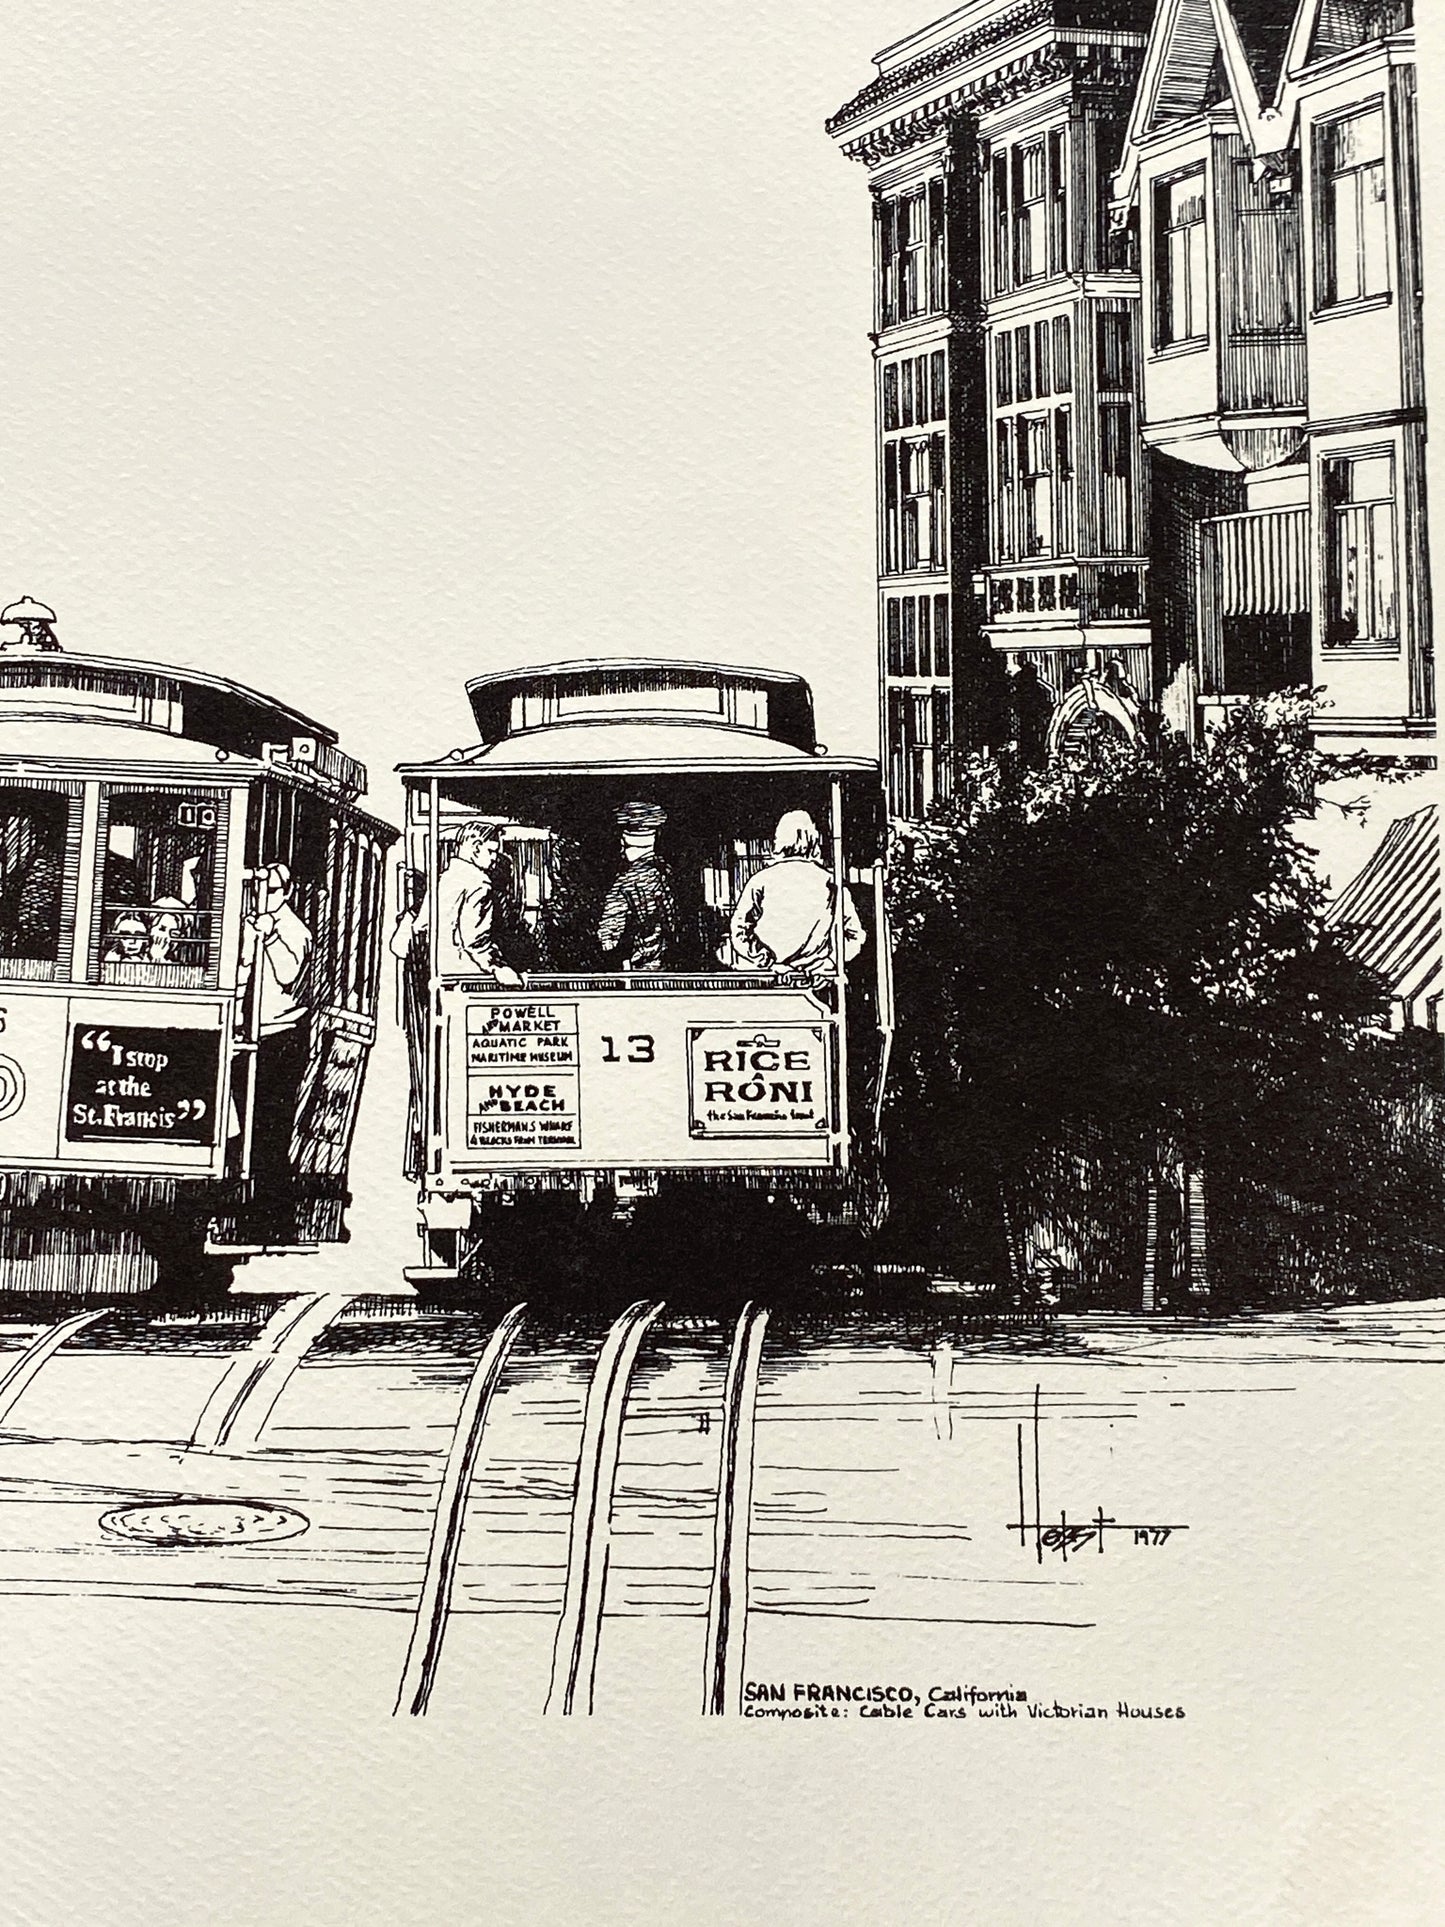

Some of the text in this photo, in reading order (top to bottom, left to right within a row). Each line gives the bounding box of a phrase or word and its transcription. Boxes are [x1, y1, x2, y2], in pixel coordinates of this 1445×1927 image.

[490, 1006, 555, 1019] POWELL
[499, 1020, 561, 1032] MARKET
[472, 1036, 568, 1048] AQUATIC PARK
[601, 1034, 655, 1063] 13
[126, 1051, 169, 1072] stop
[471, 1050, 573, 1062] MARITIME MUSEUM
[704, 1050, 811, 1071] RICE
[95, 1075, 152, 1097] at the
[489, 1084, 557, 1098] HYDE
[479, 1098, 565, 1114] AND BEACH
[707, 1109, 726, 1121] the
[1133, 1529, 1172, 1546] 1977
[743, 1681, 1028, 1706] SAN FRANCISCO, California
[743, 1700, 1186, 1721] Composite: Cable Cars with Victorian Houses
